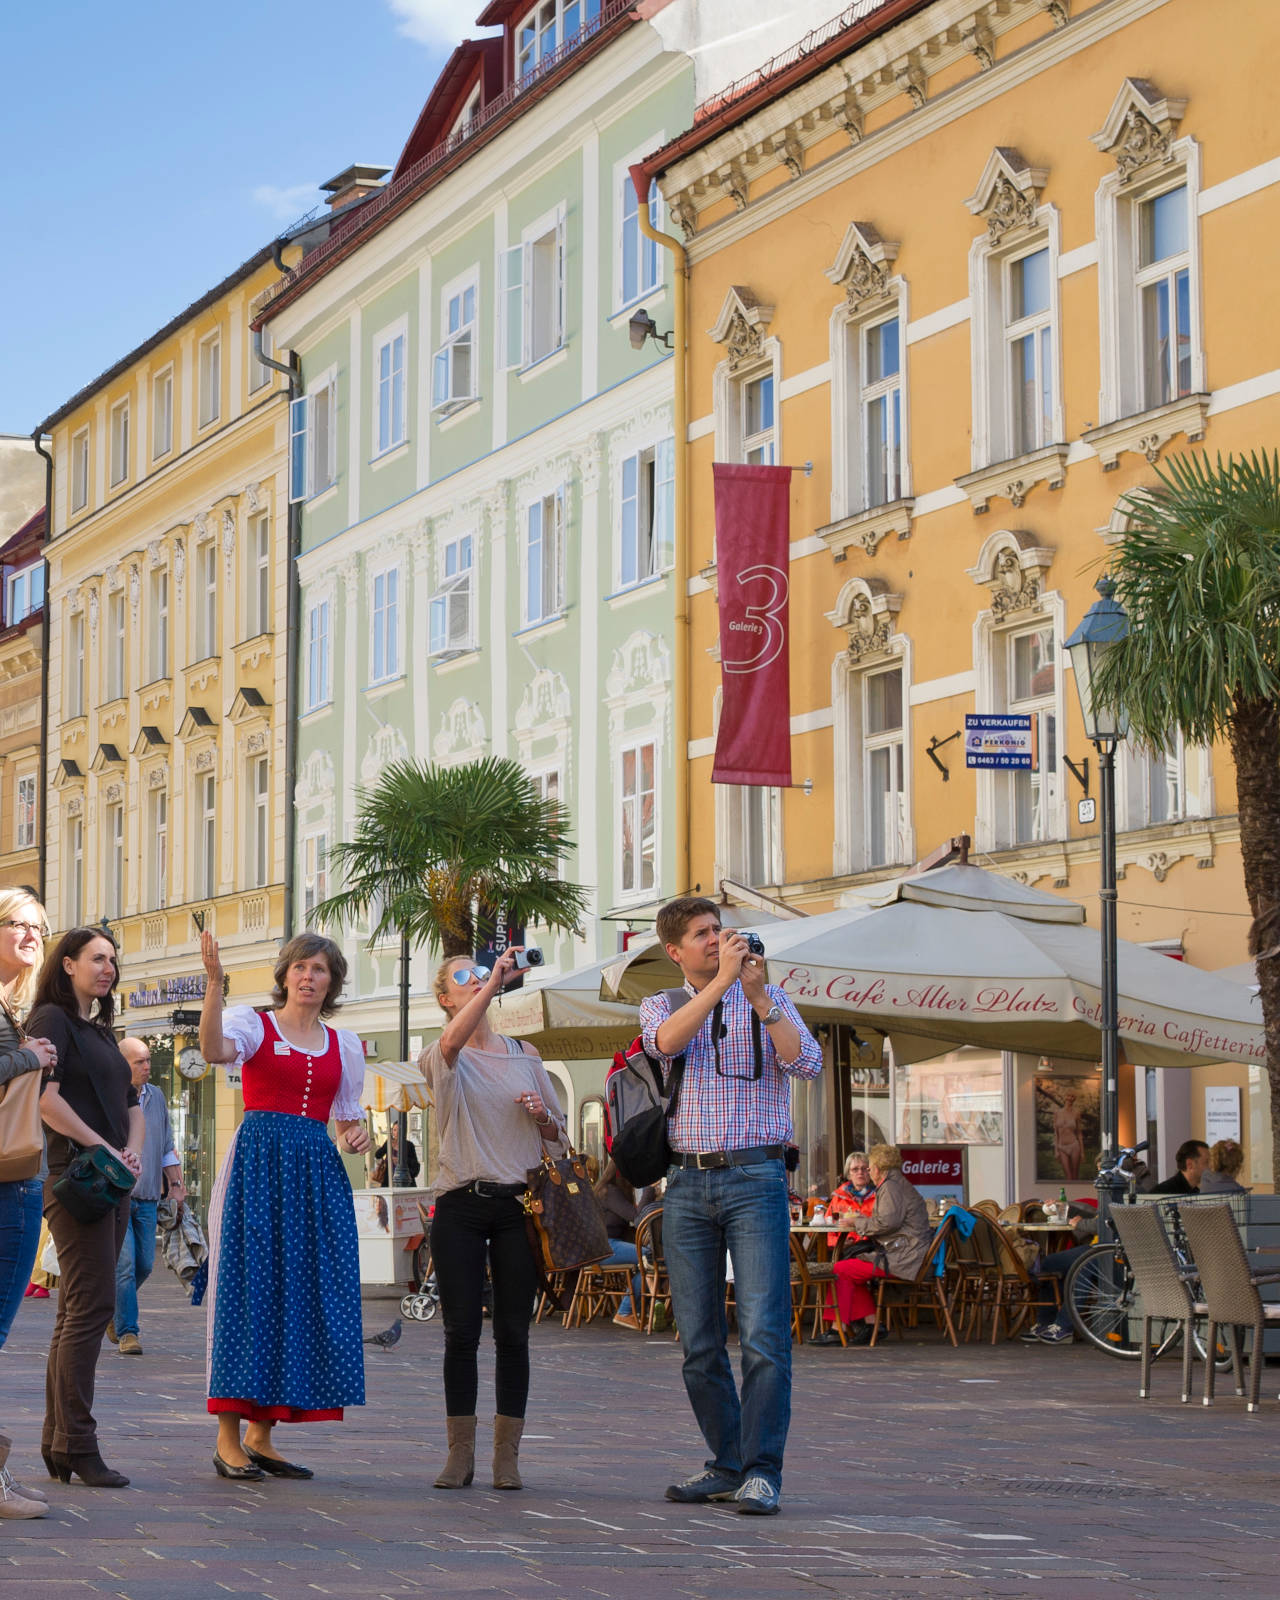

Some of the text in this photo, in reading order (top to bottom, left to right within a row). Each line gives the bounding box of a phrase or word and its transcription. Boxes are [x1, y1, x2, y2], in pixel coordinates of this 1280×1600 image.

[729, 621, 757, 633] Galerie
[967, 718, 1030, 727] ZU VERKAUFEN
[778, 967, 1059, 1013] Eis Café Alter Platz
[1072, 995, 1267, 1058] Geleria Caffetteria
[901, 1159, 961, 1176] Galerie 3
